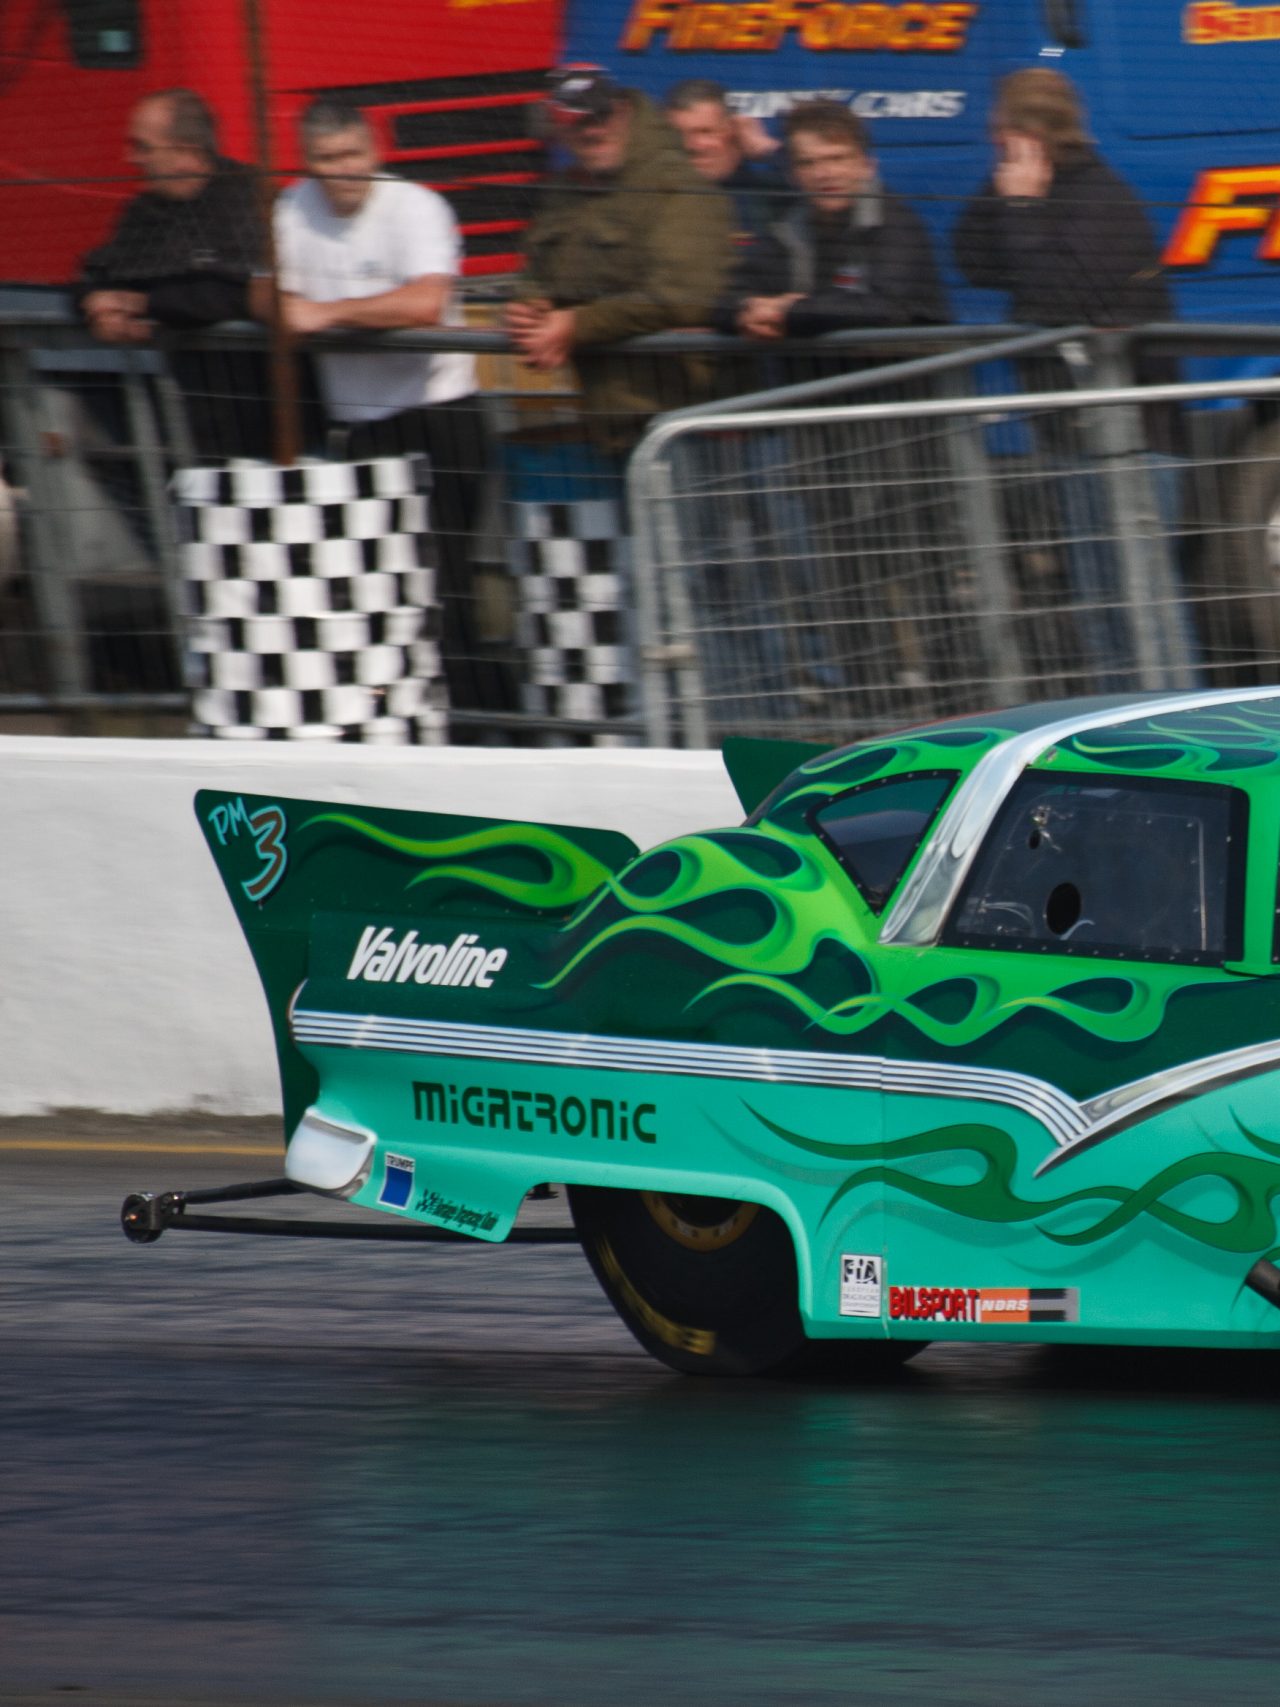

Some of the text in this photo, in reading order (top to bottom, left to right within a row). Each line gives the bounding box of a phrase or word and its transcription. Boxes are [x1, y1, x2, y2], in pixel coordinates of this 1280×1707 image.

[207, 796, 255, 846] PM
[241, 804, 288, 902] 3
[346, 925, 508, 988] Valvoline
[843, 1258, 879, 1285] FIA
[888, 1285, 1029, 1322] BILSPORT NDRS
